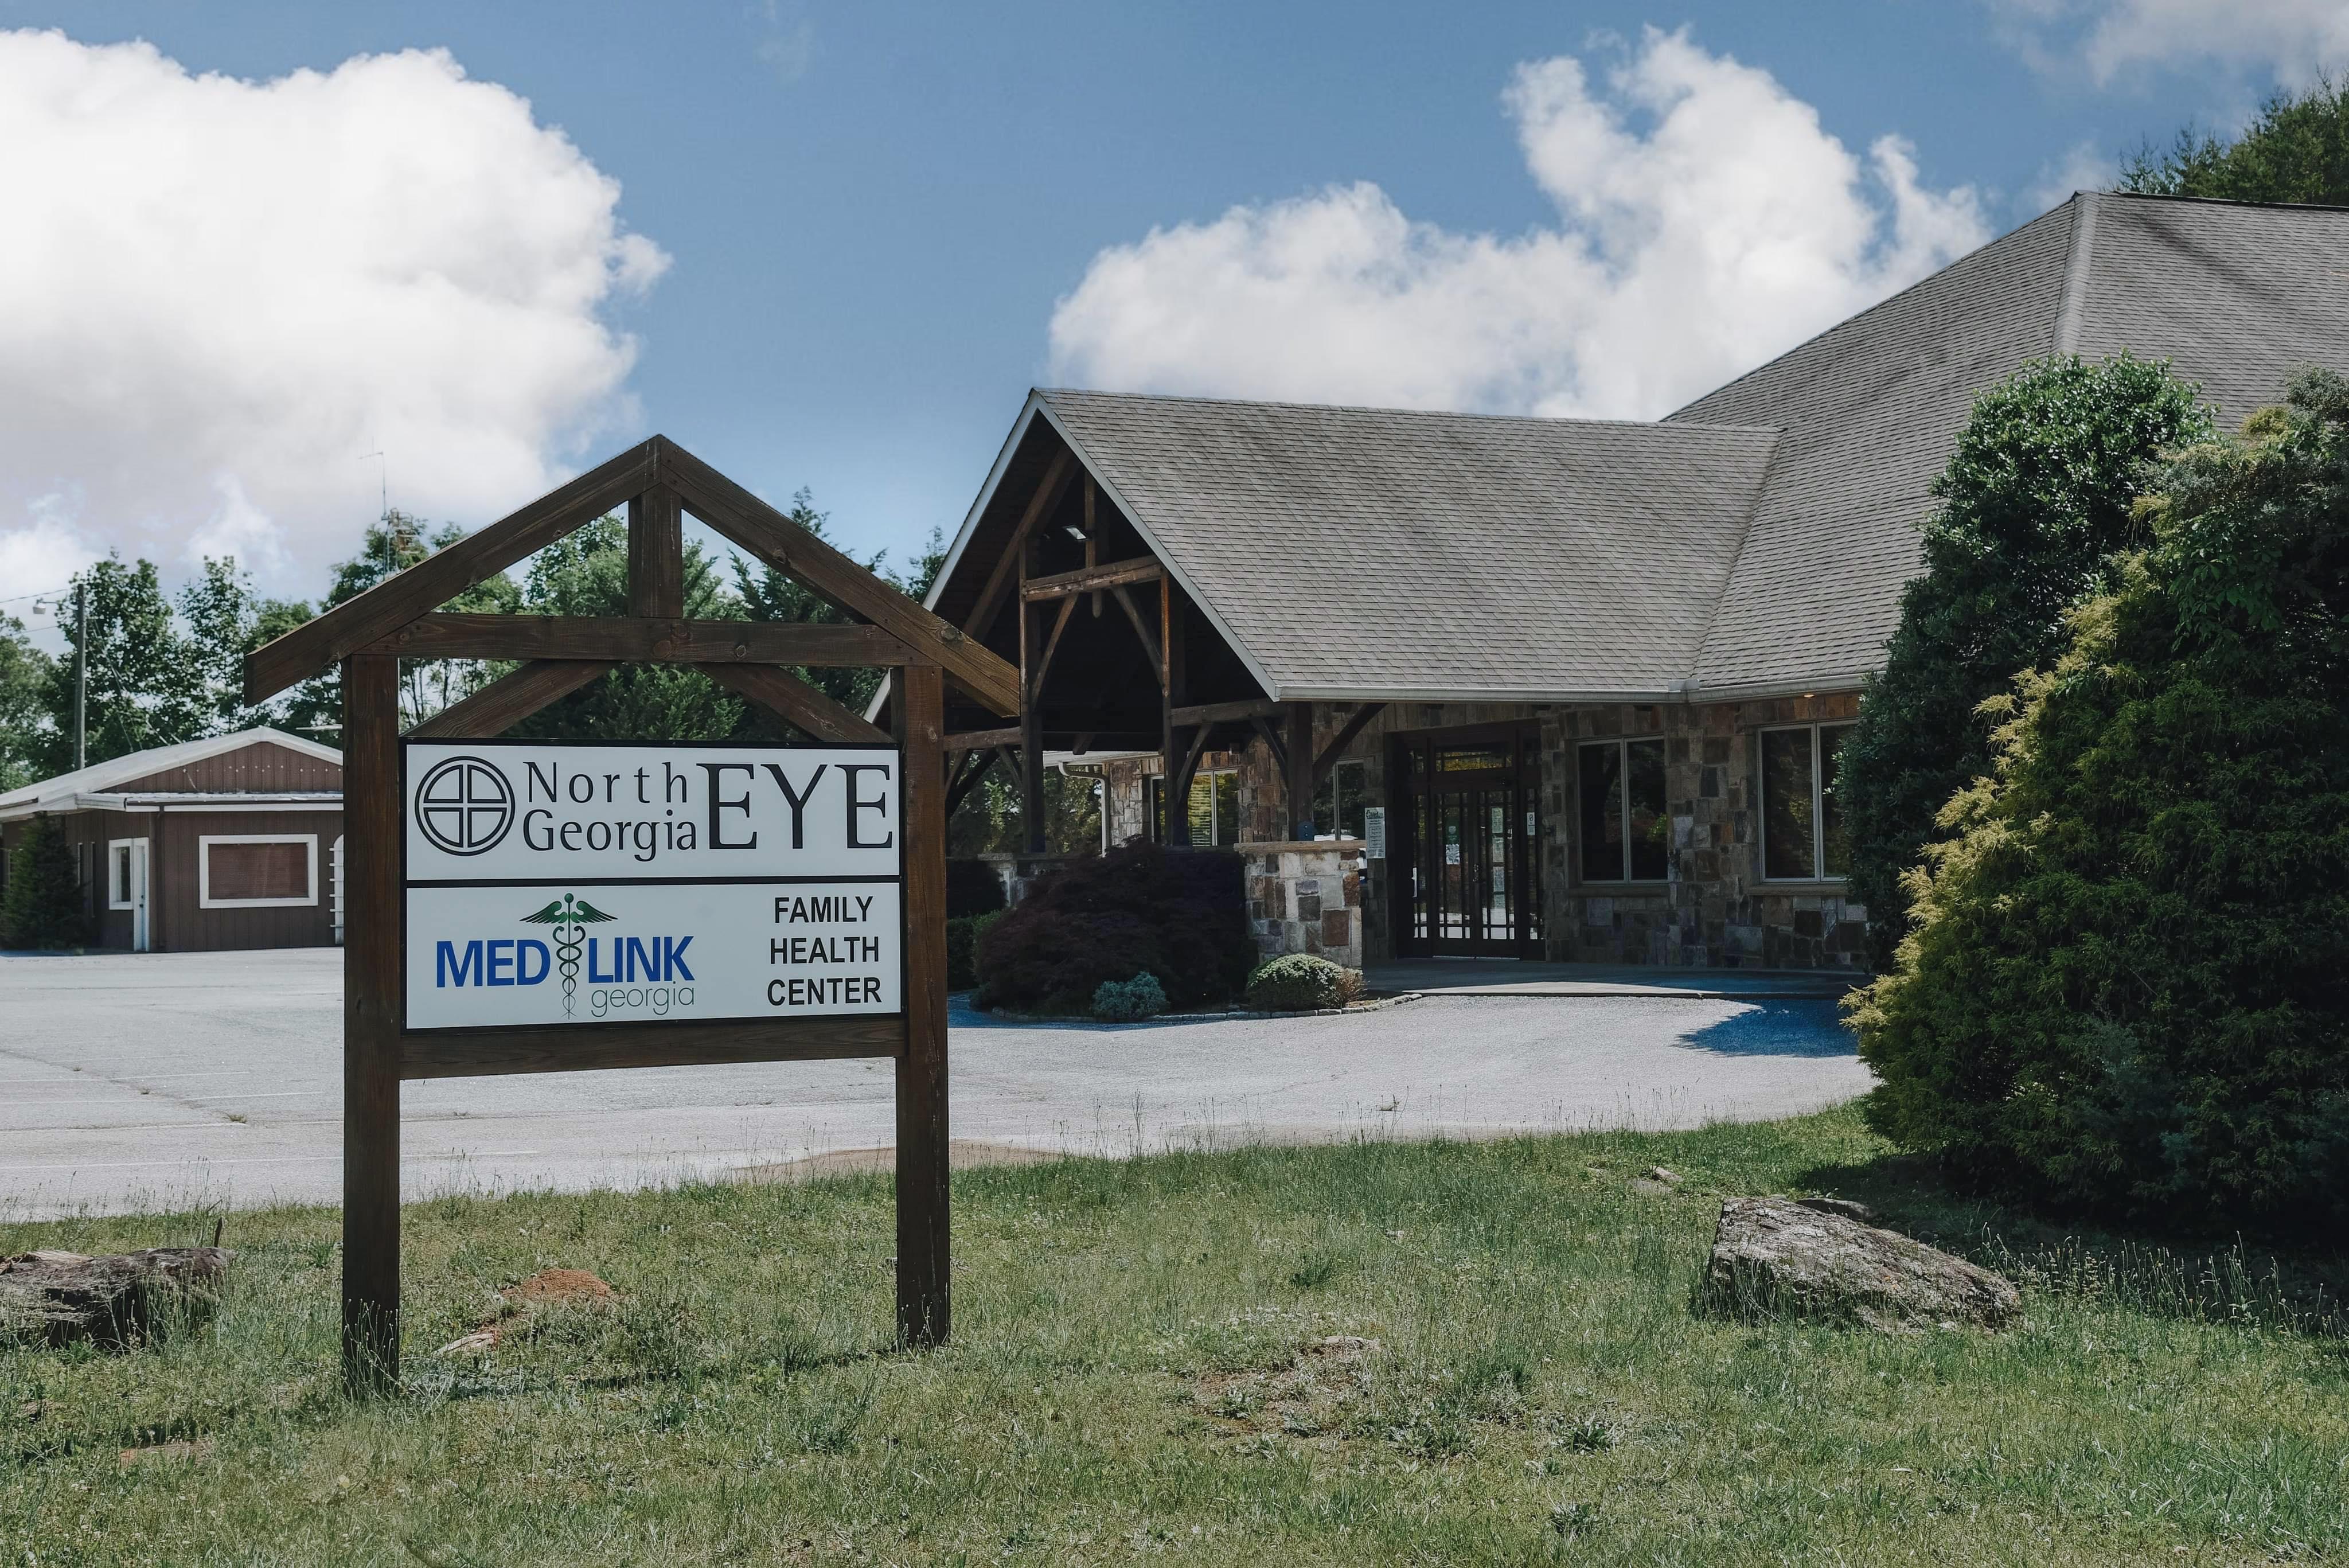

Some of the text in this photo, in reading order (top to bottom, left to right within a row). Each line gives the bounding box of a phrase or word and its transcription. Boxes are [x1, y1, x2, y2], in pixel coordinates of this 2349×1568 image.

[522, 761, 687, 803] North
[696, 763, 893, 850] EYE
[522, 809, 696, 862] Georgia
[775, 896, 873, 923] FAMILY
[436, 935, 696, 988] MED LINK
[770, 936, 879, 965] HEALTH
[591, 981, 694, 1018] georgia
[767, 977, 883, 1007] CENTER
